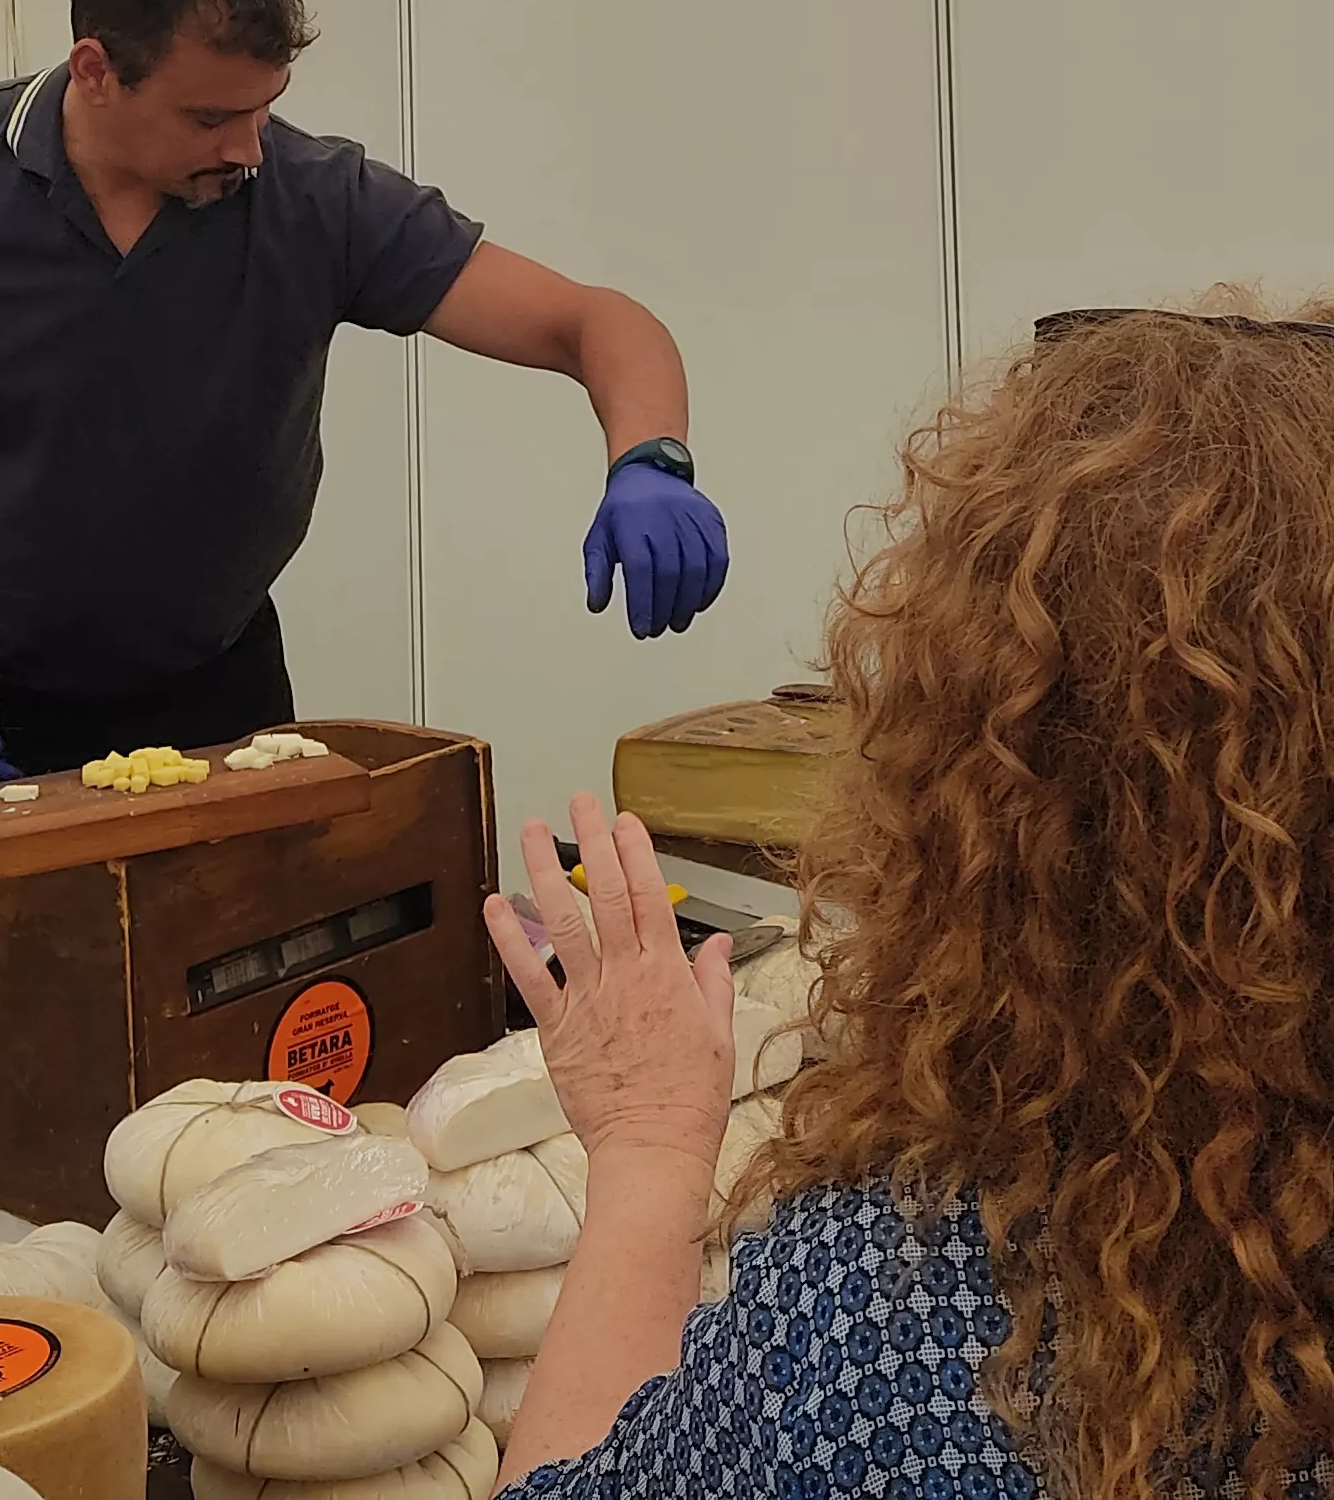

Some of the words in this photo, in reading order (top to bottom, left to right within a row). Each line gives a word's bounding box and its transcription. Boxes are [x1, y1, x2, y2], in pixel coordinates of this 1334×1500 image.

[292, 1022, 313, 1036] GRAN
[315, 1010, 349, 1028] RESERVA
[287, 1030, 353, 1068] BETARA
